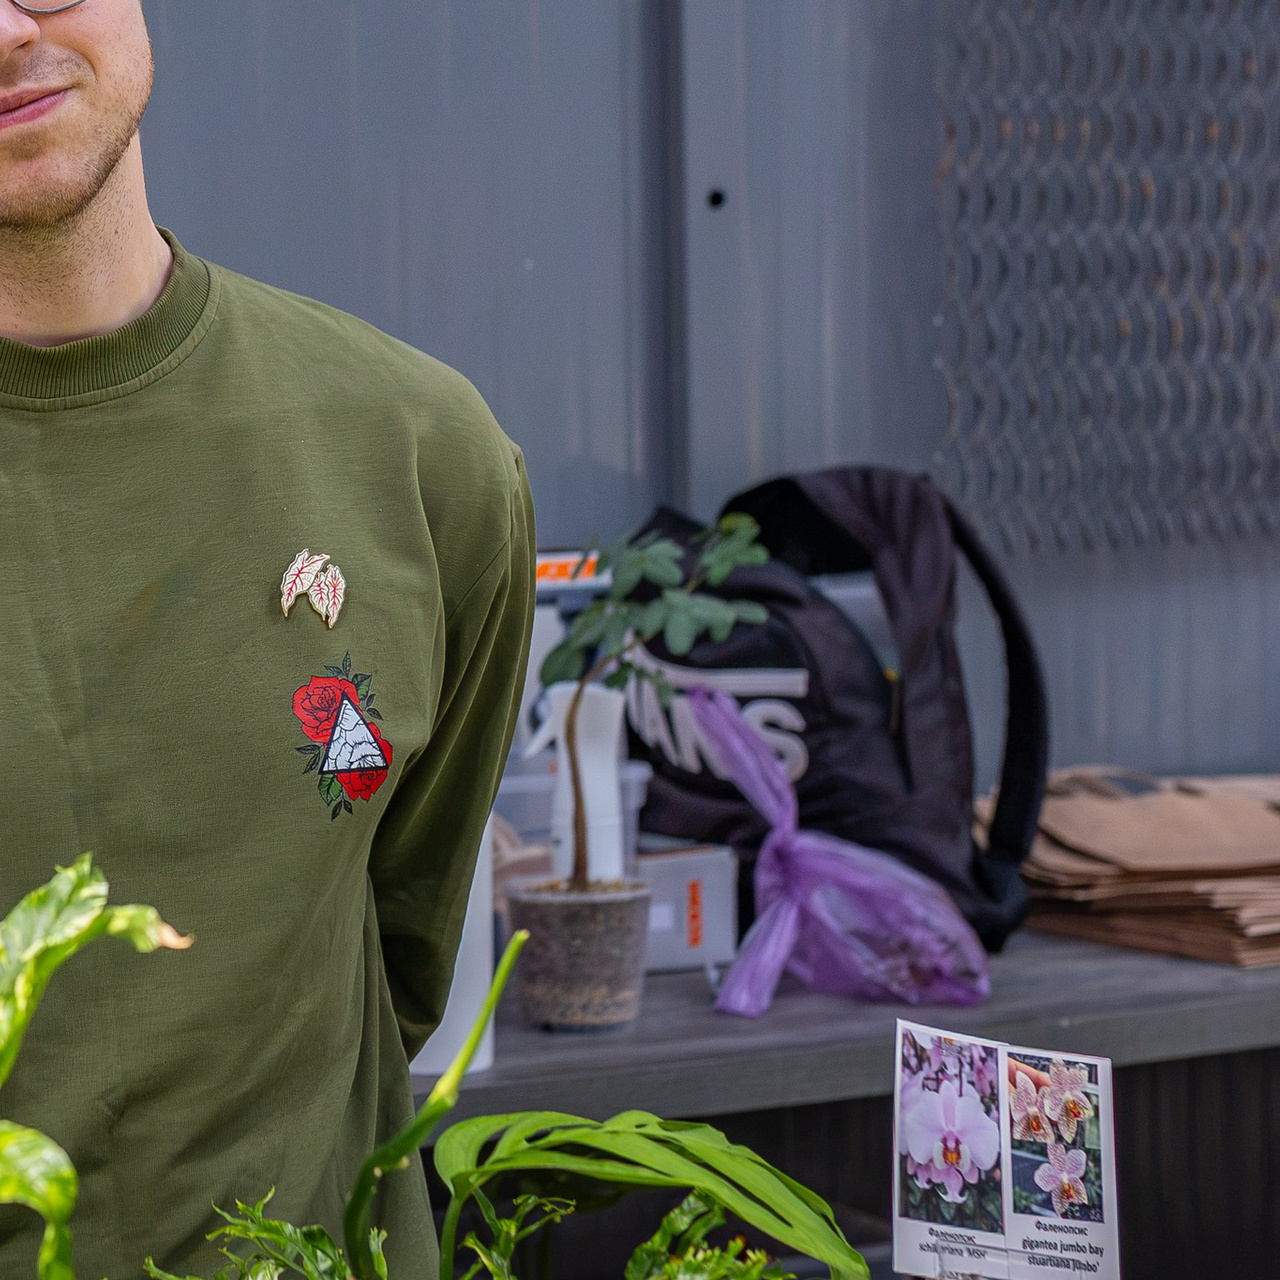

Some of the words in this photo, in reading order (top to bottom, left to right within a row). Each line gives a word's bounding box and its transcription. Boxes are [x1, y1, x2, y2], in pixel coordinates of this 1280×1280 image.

[1035, 1220, 1089, 1236] Фаленопсис
[1021, 1236, 1058, 1251] gigantea
[1060, 1240, 1087, 1254] jumbo
[1088, 1242, 1104, 1258] bay
[1027, 1254, 1070, 1270] stuartiana
